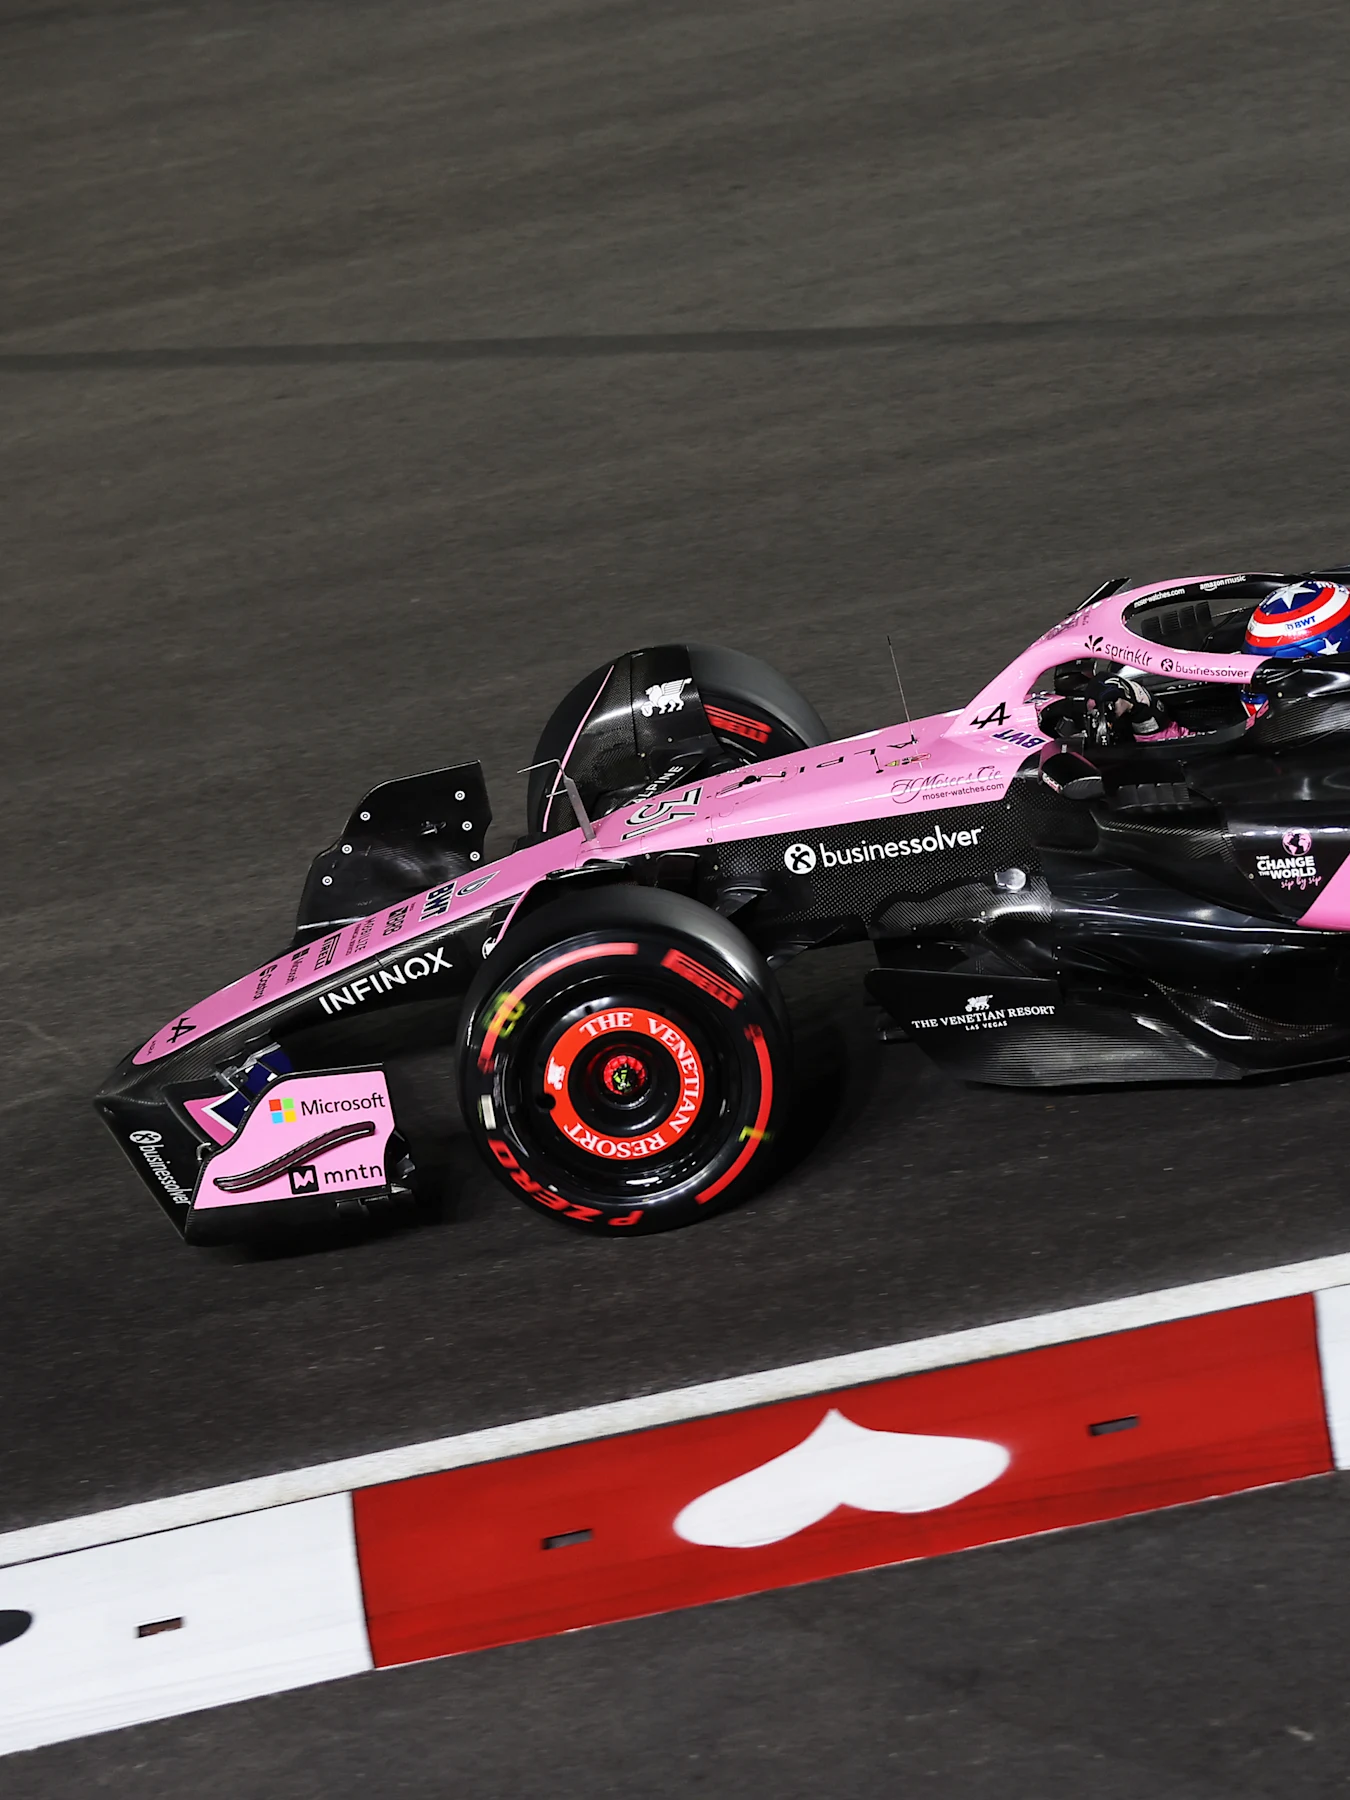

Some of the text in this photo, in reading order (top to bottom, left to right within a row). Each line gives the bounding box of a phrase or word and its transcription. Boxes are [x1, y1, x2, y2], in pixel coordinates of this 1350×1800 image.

[1200, 575, 1247, 592] amazon music
[1133, 588, 1186, 609] moser-watches.com
[1294, 615, 1316, 629] BWT
[1105, 643, 1152, 667] sprinklr
[991, 728, 1048, 751] BWT
[922, 782, 1005, 801] moser-watches.com
[820, 825, 982, 868] businessolver
[1257, 855, 1315, 870] CHANGE
[1270, 867, 1317, 879] WORLD
[418, 881, 457, 922] BWT
[313, 932, 342, 971] PIRELLI
[253, 972, 271, 1001] Castrol
[318, 946, 454, 1015] INFINOX
[911, 1005, 1056, 1029] THE VENETIAN RESORT
[965, 1020, 1008, 1031] LAS VEGAS
[562, 1012, 700, 1159] THE VENETIAN RESORT
[301, 1092, 386, 1117] Microsoft
[138, 1142, 192, 1206] businessolver
[324, 1162, 384, 1185] mntn
[487, 1138, 645, 1226] P ZERO
